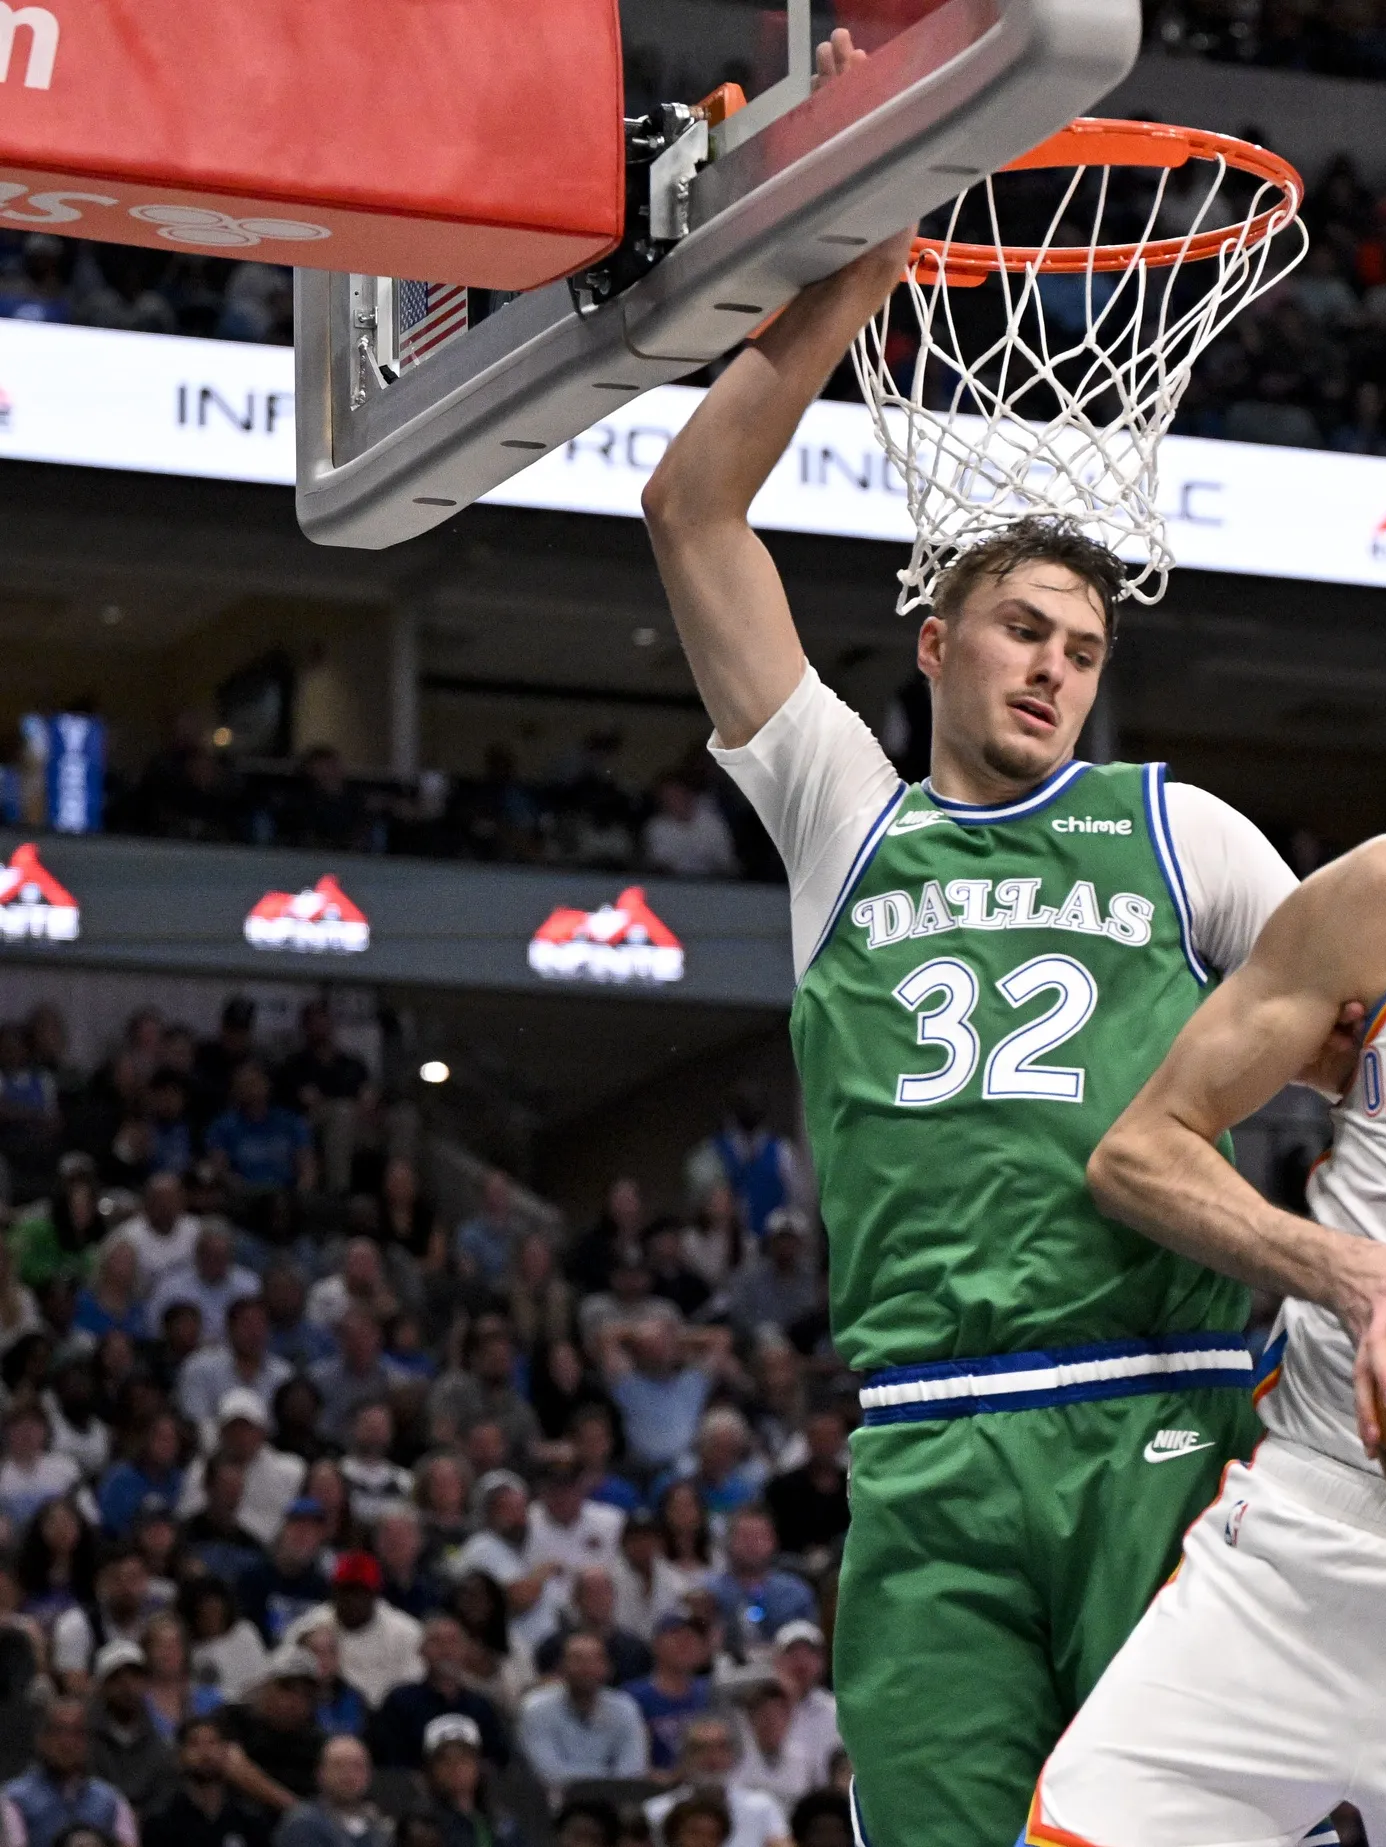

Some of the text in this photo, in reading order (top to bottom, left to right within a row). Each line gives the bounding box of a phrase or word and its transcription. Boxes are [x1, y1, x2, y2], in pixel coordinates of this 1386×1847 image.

[902, 810, 944, 825] NIKE
[1052, 816, 1132, 835] chime
[852, 878, 1154, 949] DALLAS
[893, 954, 1098, 1107] 32
[1153, 1430, 1200, 1450] NIKE
